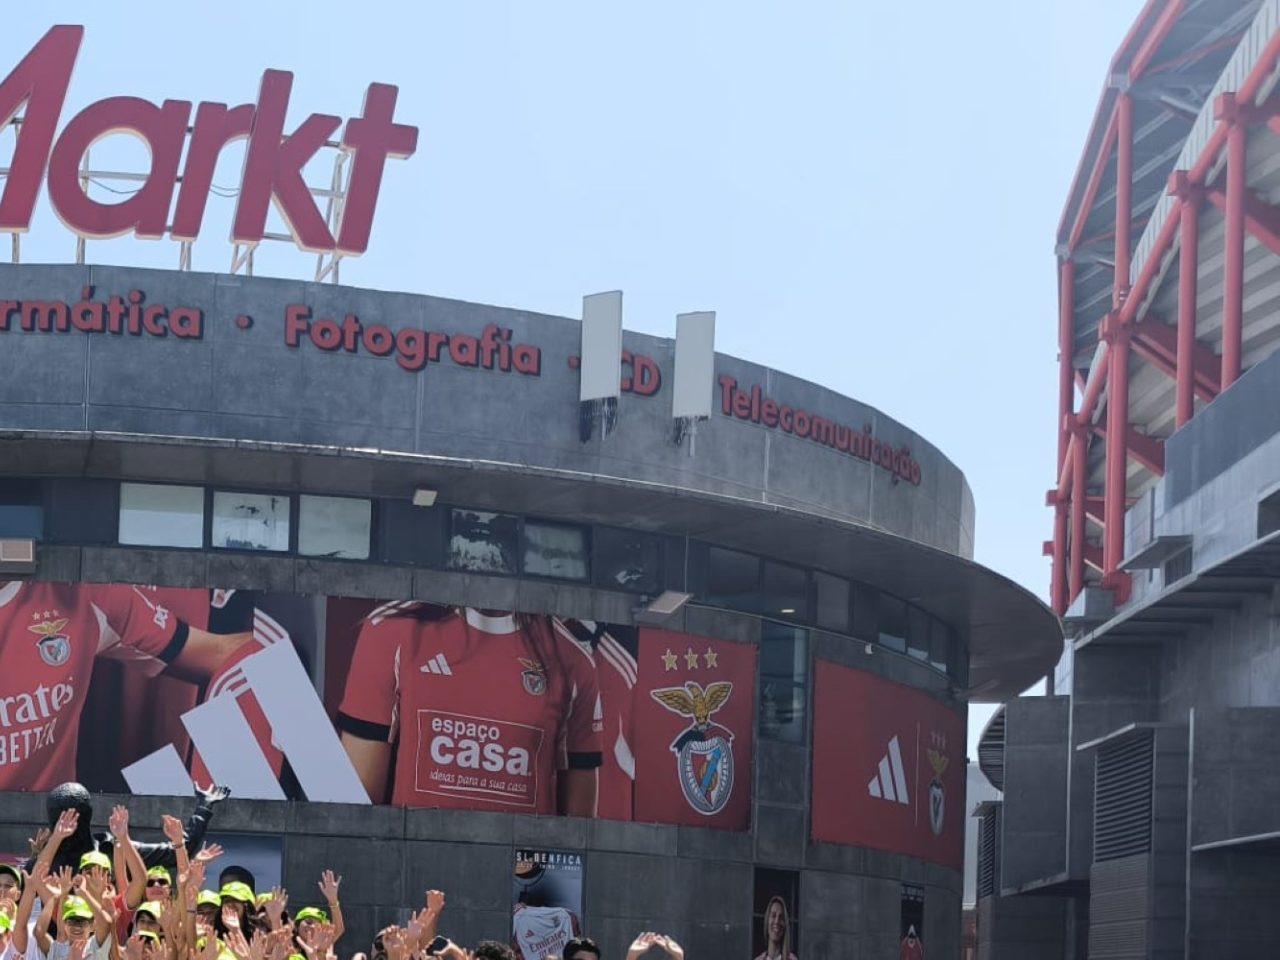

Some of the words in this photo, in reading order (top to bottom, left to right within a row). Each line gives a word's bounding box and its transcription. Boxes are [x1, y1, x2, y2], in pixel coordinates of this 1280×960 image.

[431, 717, 500, 743] espaço
[430, 735, 530, 777] casa
[516, 851, 529, 862] SL
[534, 853, 581, 865] BENFICA
